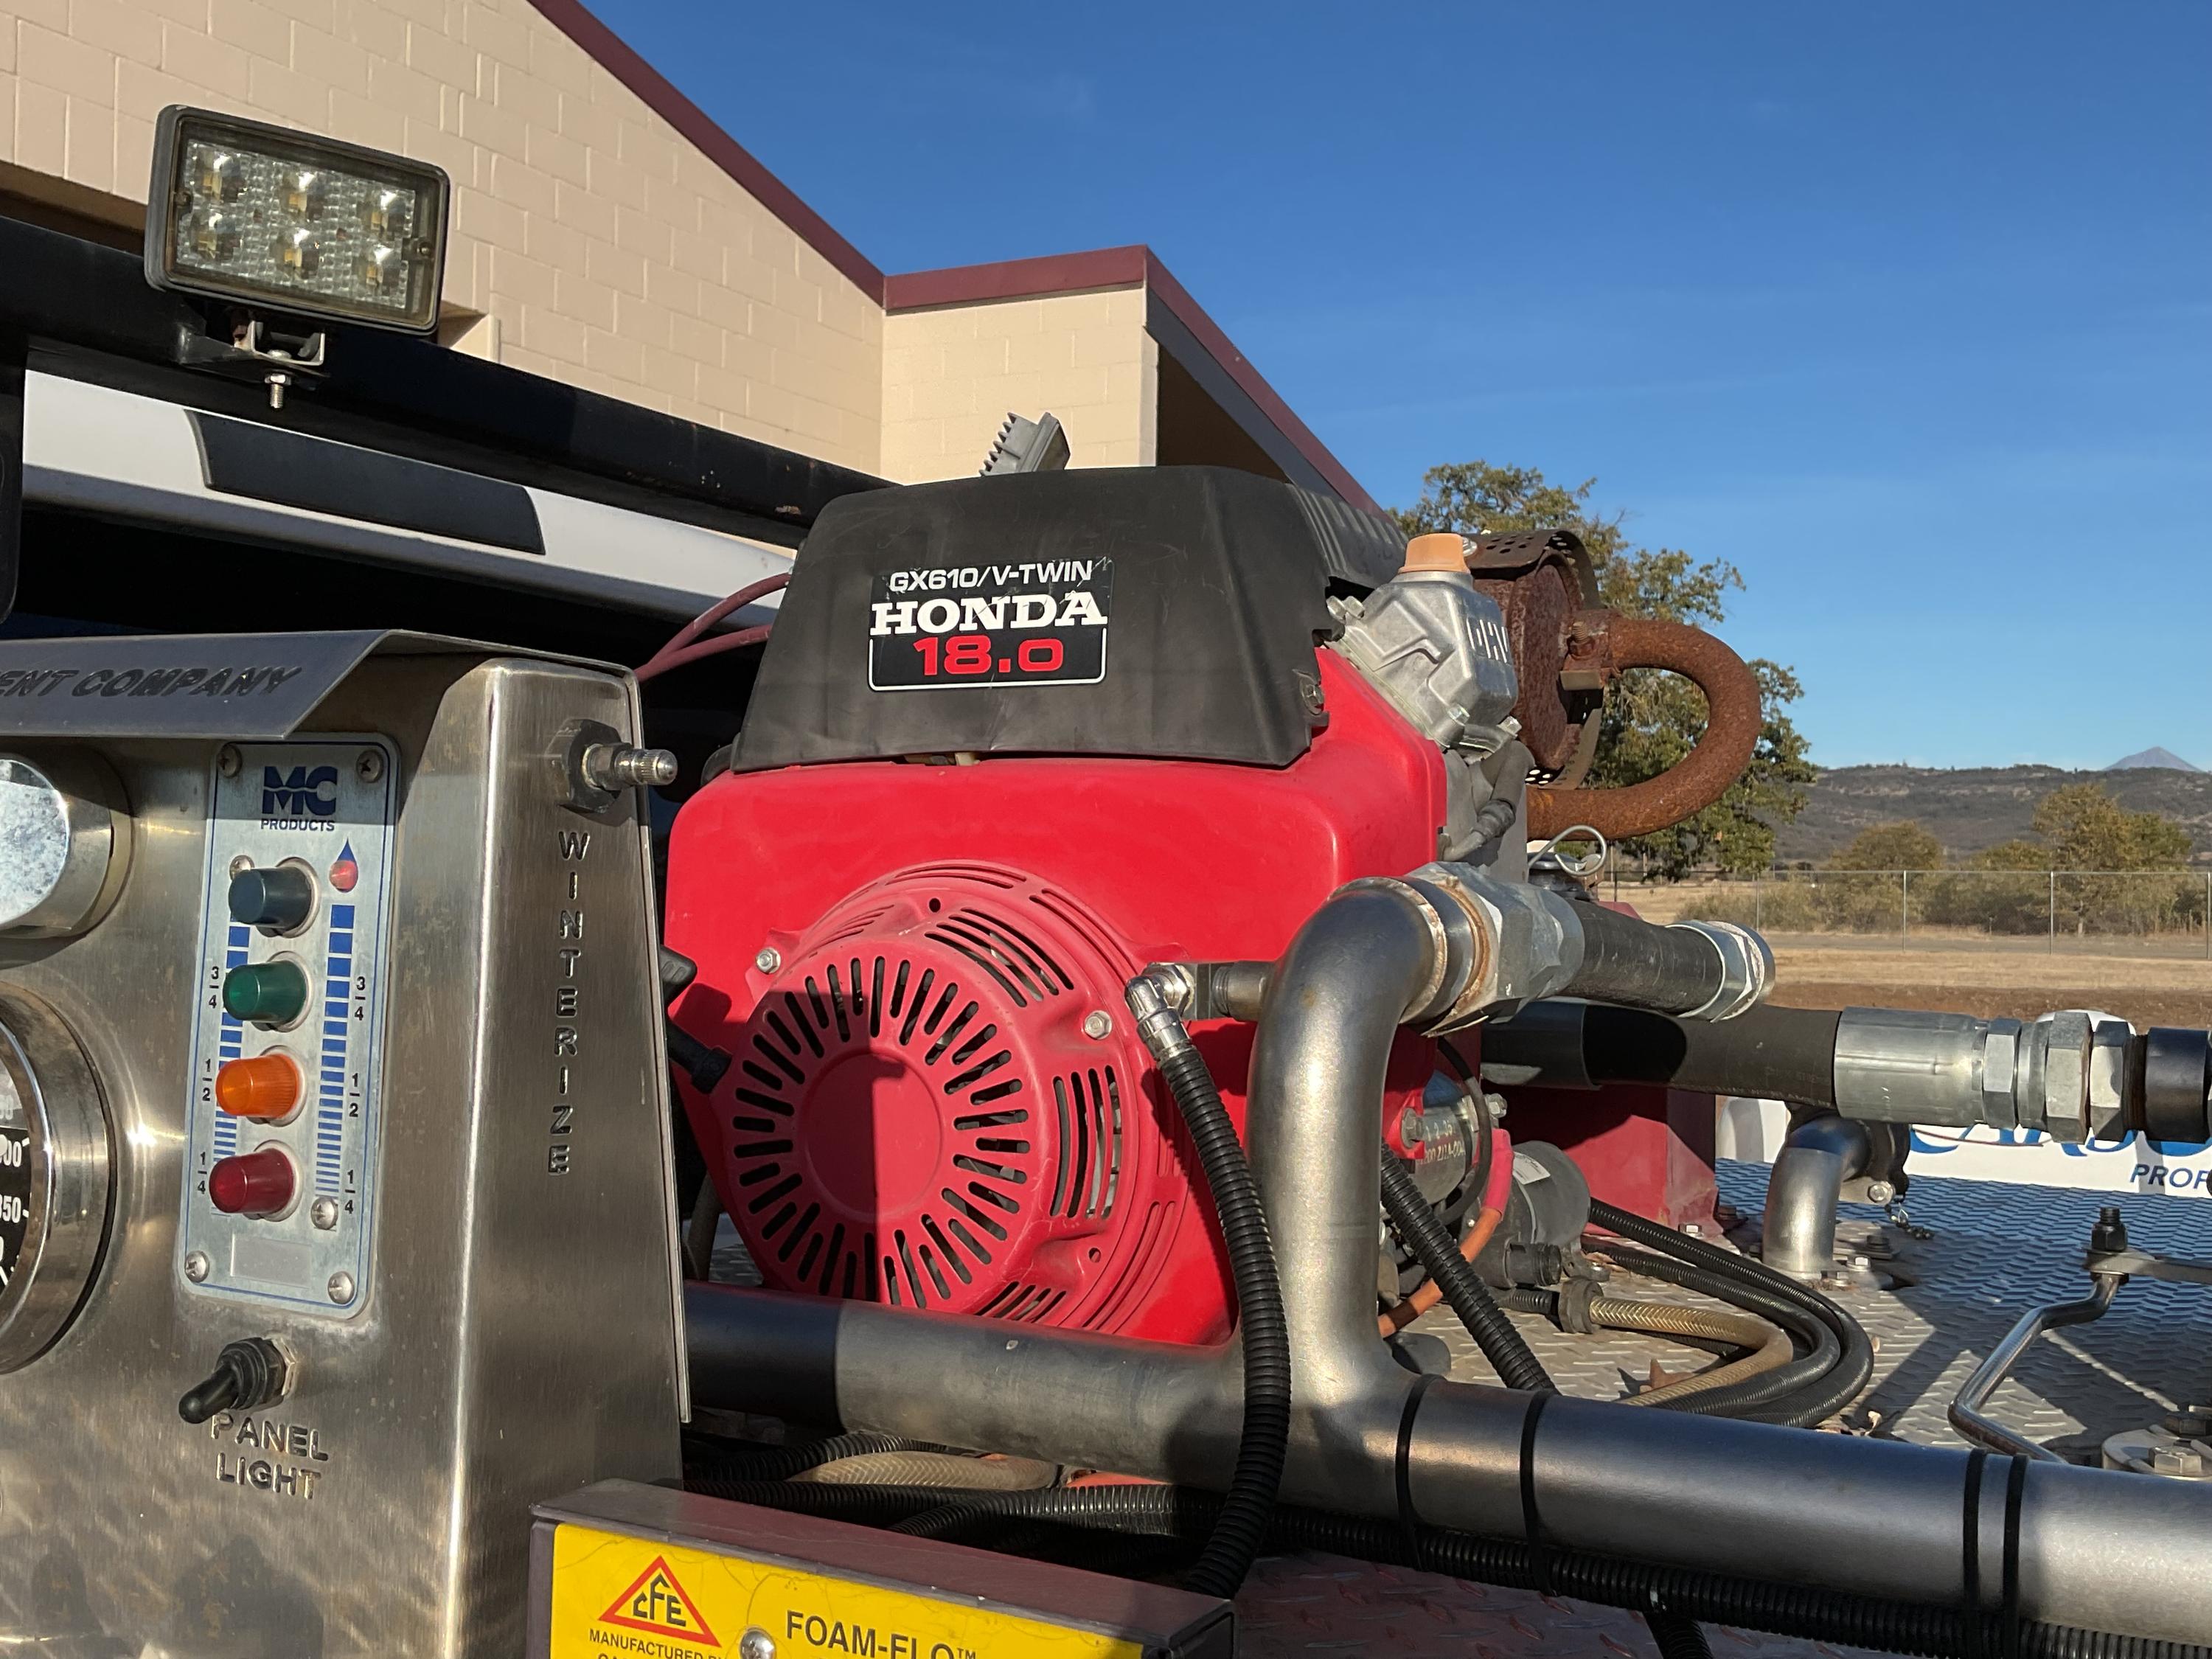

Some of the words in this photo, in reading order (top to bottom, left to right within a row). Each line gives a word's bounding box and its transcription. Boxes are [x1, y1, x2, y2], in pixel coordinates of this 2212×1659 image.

[889, 560, 1093, 591] GX610/V-TWIN
[869, 590, 1108, 636] HONDA
[913, 634, 1064, 676] 18.0
[72, 667, 302, 698] COMPANY
[262, 765, 338, 816] MC
[260, 818, 335, 832] PRODUCTS
[548, 830, 591, 1174] WINTERIZE
[0, 1139, 22, 1167] 00
[0, 1194, 21, 1223] 50
[211, 1413, 328, 1461] PANEL
[215, 1453, 321, 1500] LIGHT
